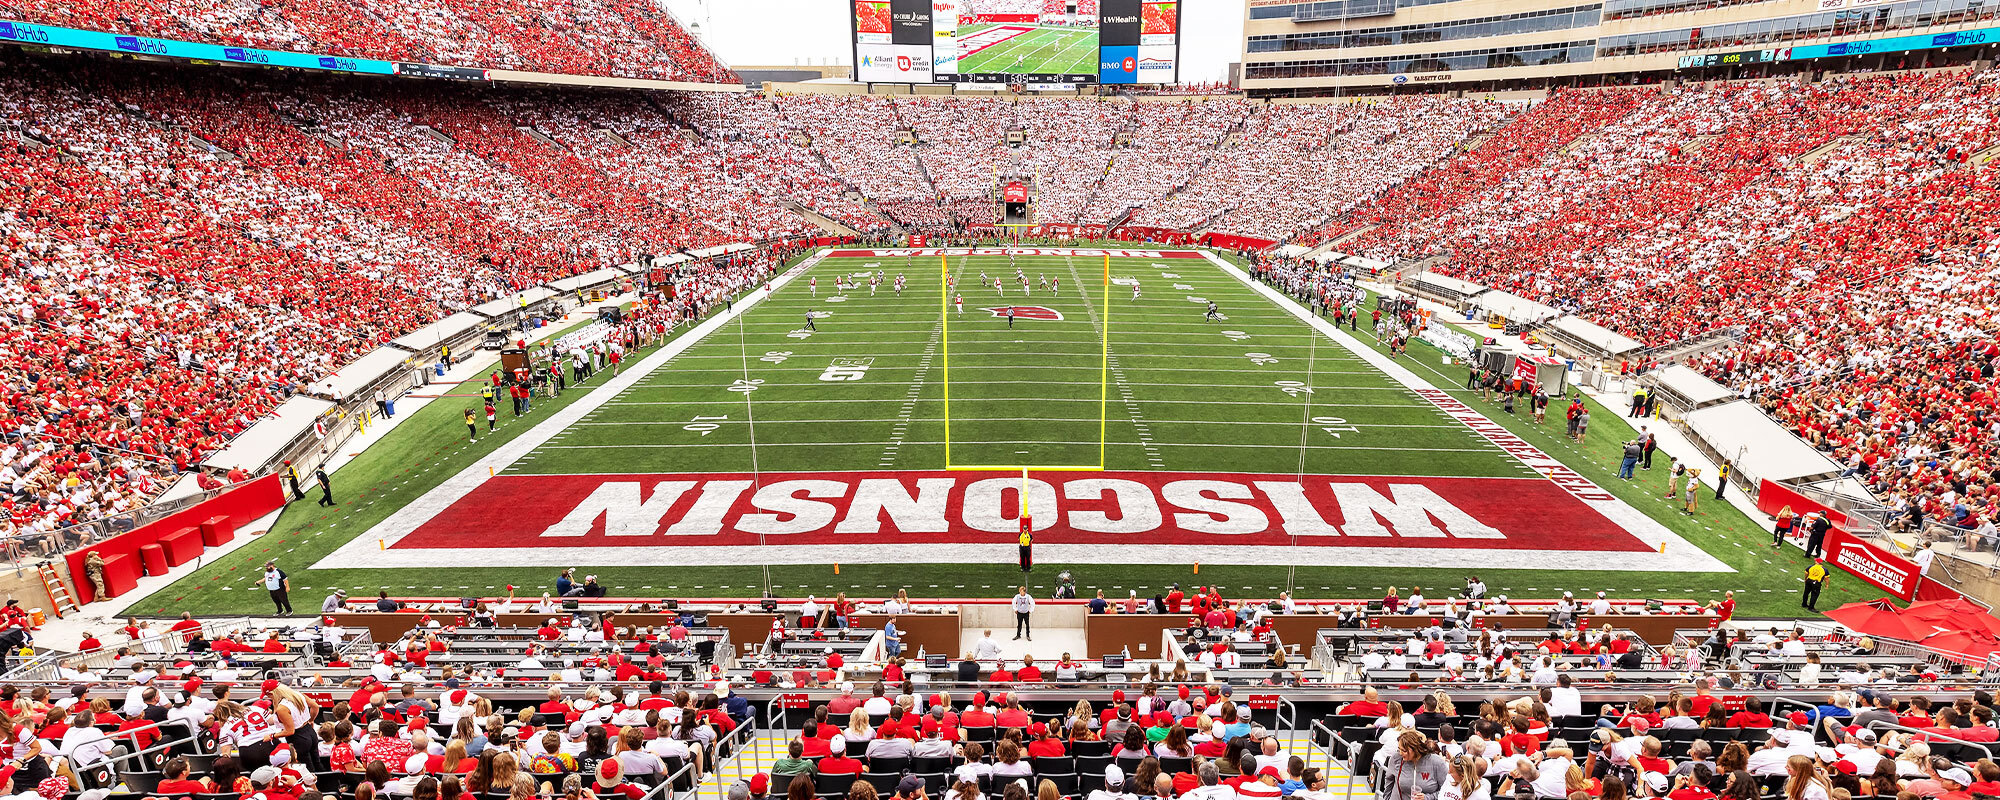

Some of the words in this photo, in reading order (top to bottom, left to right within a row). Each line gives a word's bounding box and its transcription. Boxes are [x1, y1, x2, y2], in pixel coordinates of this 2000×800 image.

[1101, 62, 1120, 70] BMO
[1723, 54, 1740, 63] 6:05
[727, 378, 765, 392] 20
[1274, 380, 1315, 394] 20
[683, 414, 728, 431] 10
[1311, 416, 1360, 434] 10
[1414, 388, 1476, 414] BARRY
[1456, 415, 1551, 460] ALVAREZ
[1532, 464, 1616, 501] FIELD
[538, 478, 1507, 538] WISCONSIN
[1839, 547, 1877, 571] AMERICAN
[1878, 565, 1906, 584] FAMILY
[1842, 558, 1897, 589] INSURANCE
[1258, 632, 1270, 642] 20
[1229, 654, 1235, 665] 1
[231, 711, 268, 737] 79
[1421, 772, 1430, 780] W
